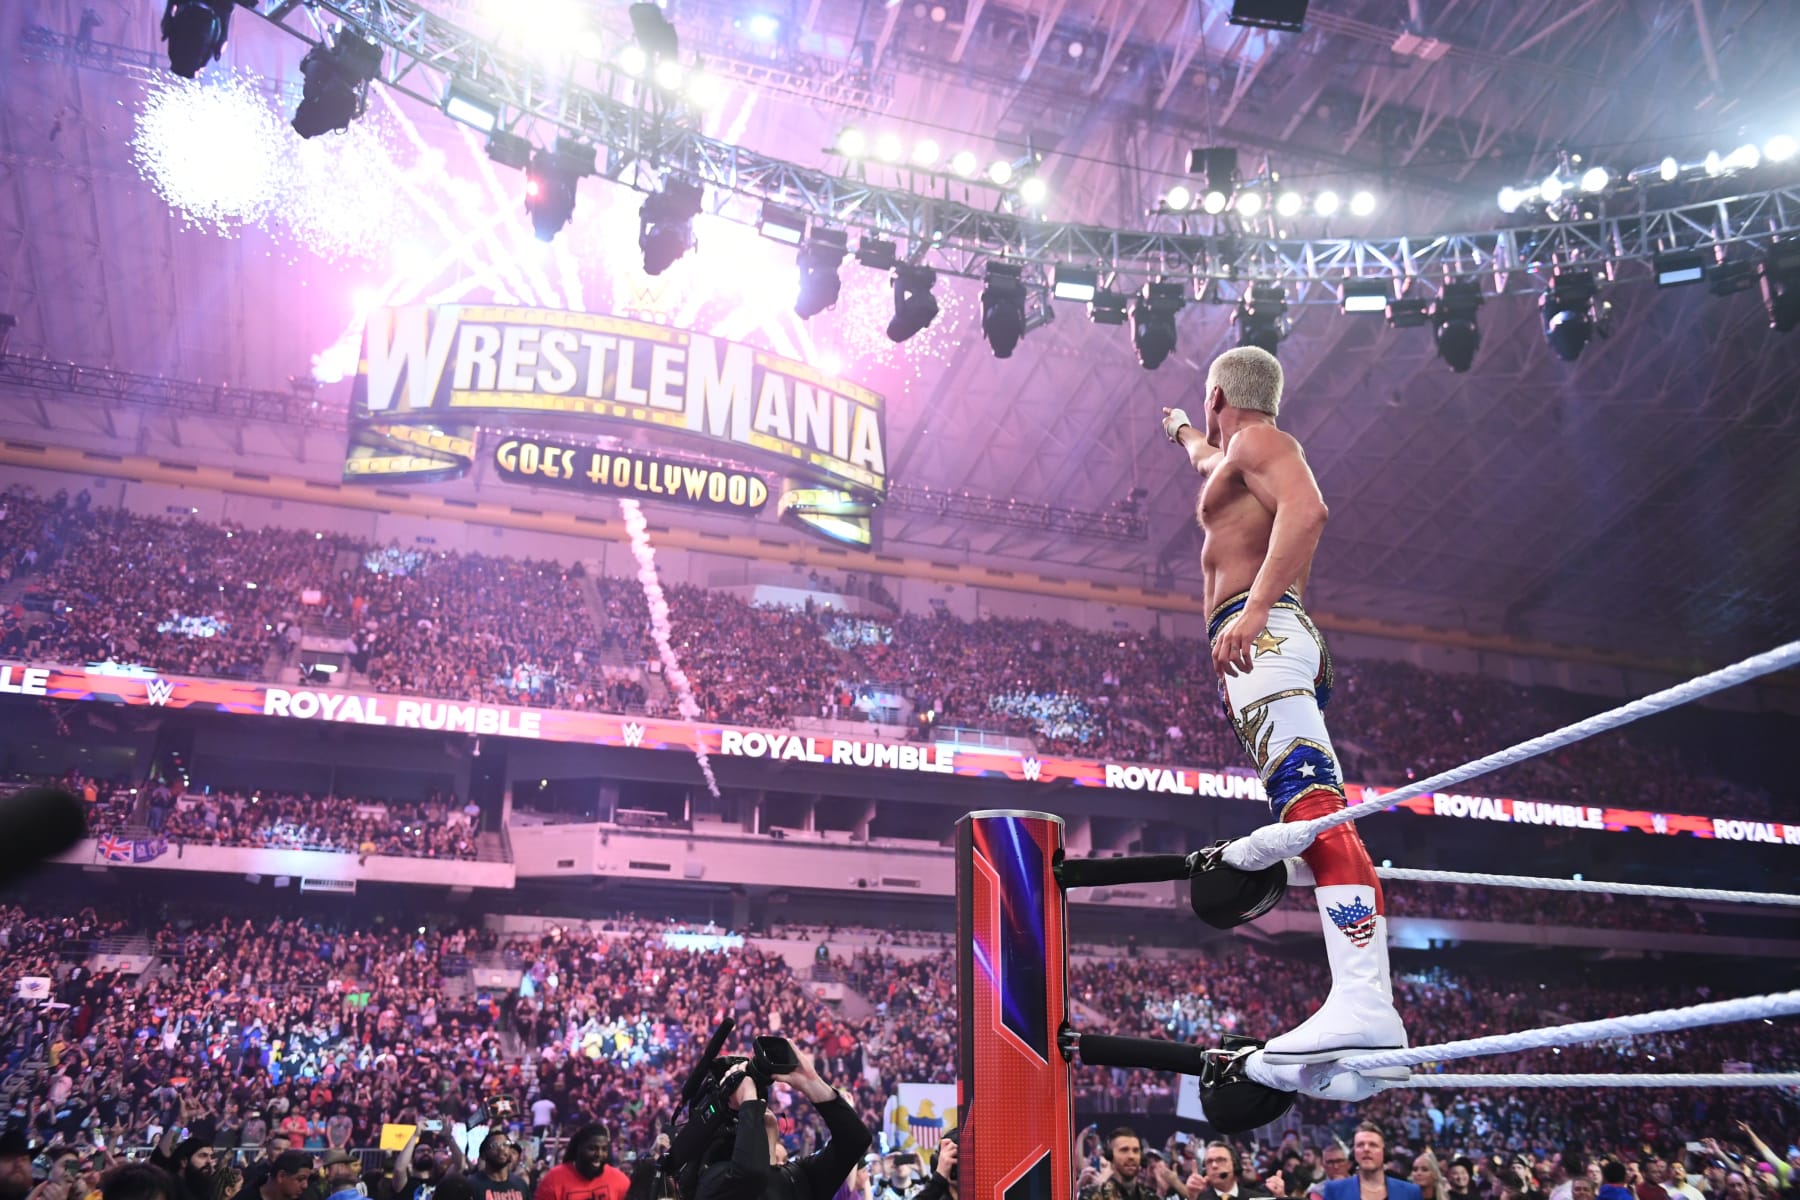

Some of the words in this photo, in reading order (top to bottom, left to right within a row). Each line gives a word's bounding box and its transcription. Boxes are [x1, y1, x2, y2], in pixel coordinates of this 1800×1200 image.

[496, 440, 576, 479] GOES
[586, 453, 768, 508] HOLLYWOOD
[263, 688, 386, 725] ROYAL
[396, 700, 541, 737] RUMBLE
[721, 729, 824, 762] ROYAL
[832, 740, 954, 773] RUMBLE
[1105, 764, 1194, 795] ROYAL
[1433, 793, 1511, 822] ROYAL
[1512, 800, 1604, 830] RUMBLE
[1712, 818, 1783, 844] ROYAL
